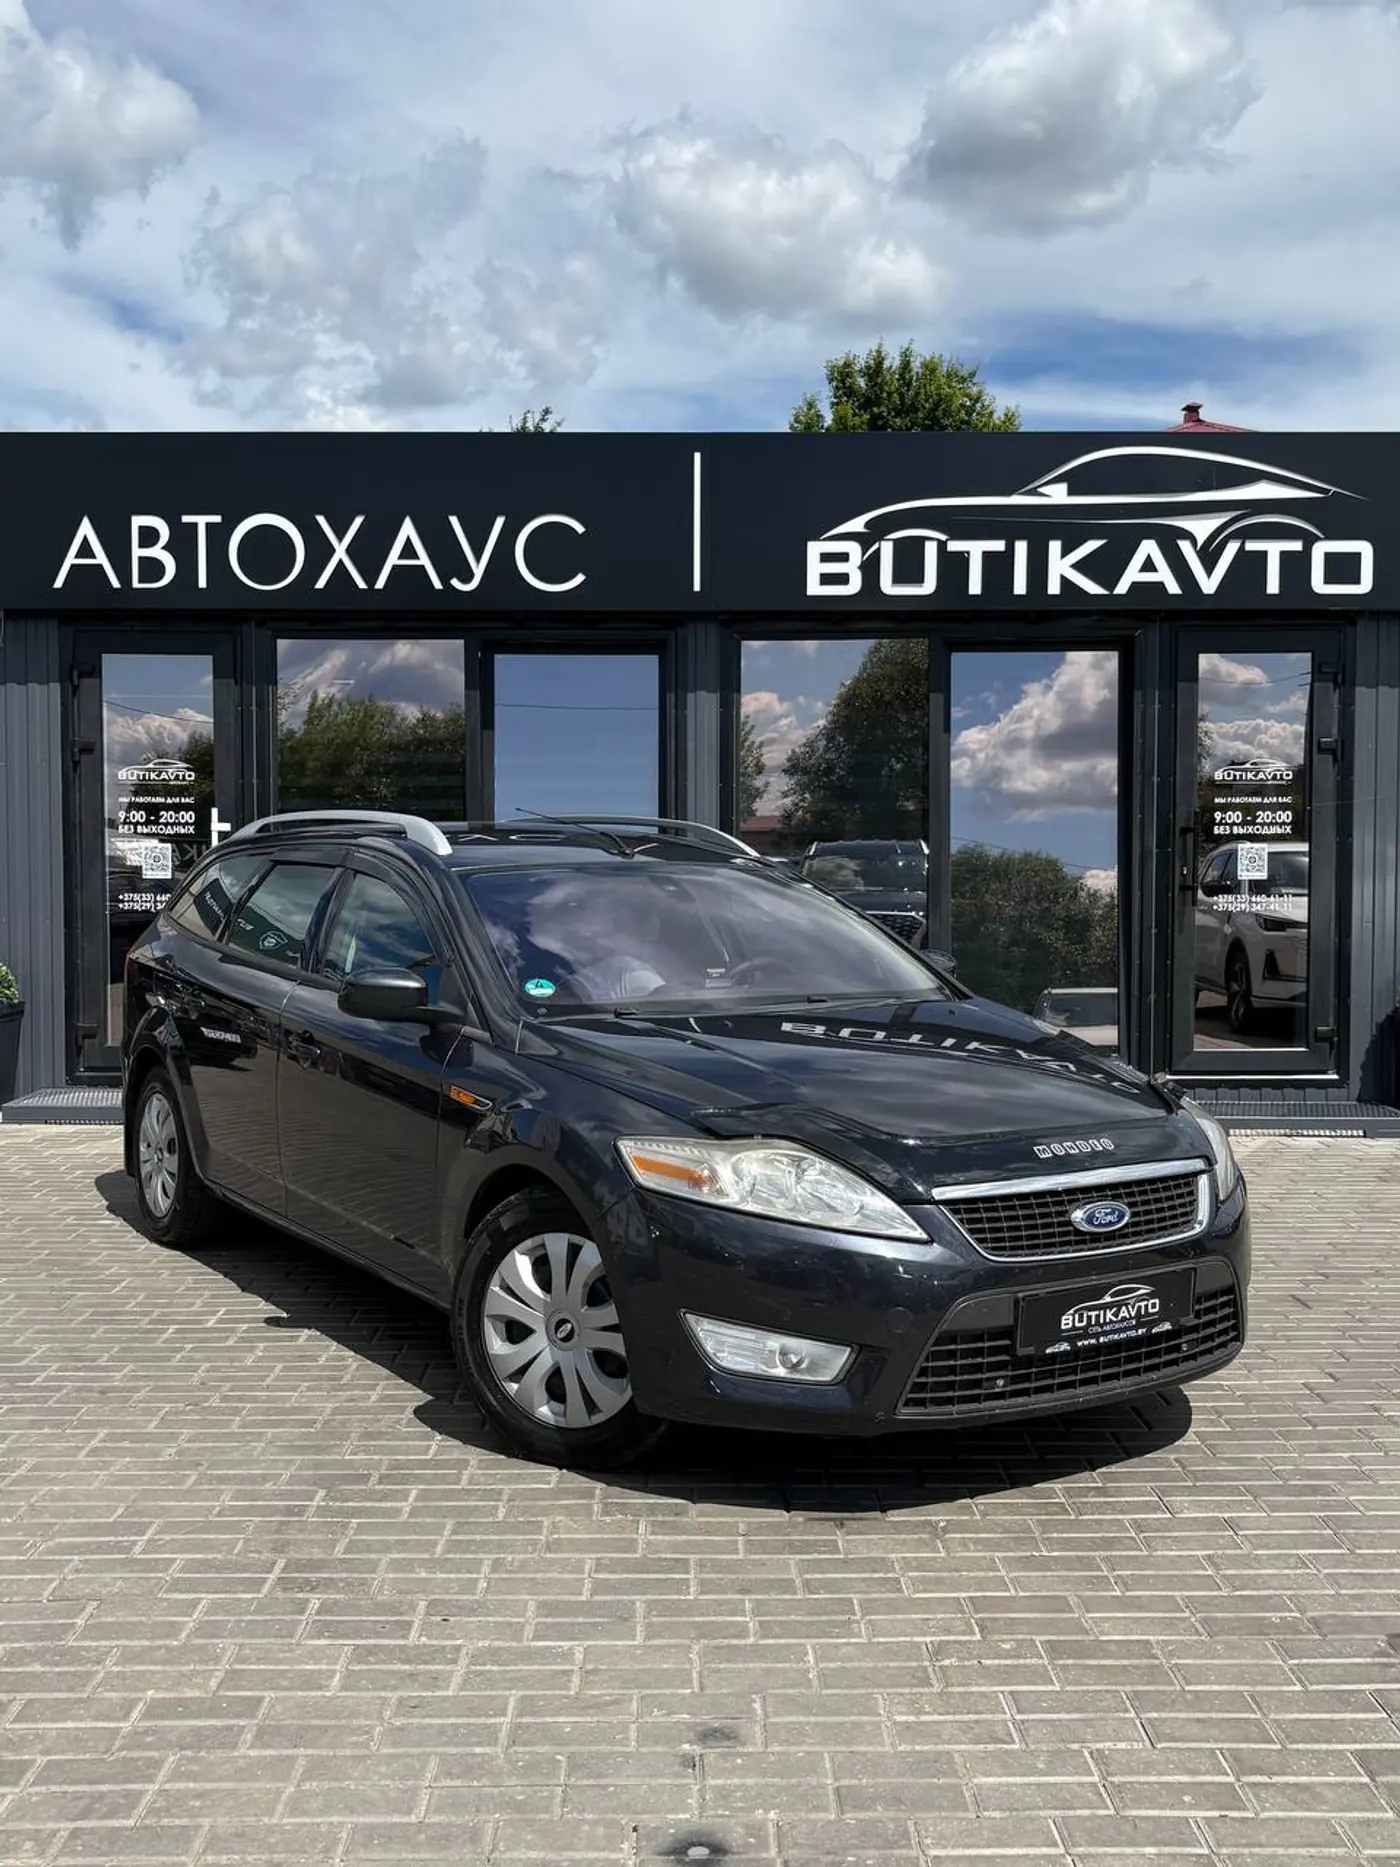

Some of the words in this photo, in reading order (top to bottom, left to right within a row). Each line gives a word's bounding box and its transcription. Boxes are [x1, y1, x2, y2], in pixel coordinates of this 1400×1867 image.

[53, 513, 587, 592] АВТОХАУС
[806, 539, 1373, 596] BUTIKAVTO
[1214, 770, 1293, 780] BUTIKAVTO
[118, 811, 146, 823] 9:00
[159, 811, 195, 823] 20:00
[1214, 811, 1242, 823] 9:00
[1256, 811, 1292, 823] 20:00
[137, 825, 195, 835] ВЫХОДНЫХ
[1214, 825, 1230, 834] БЕЗ
[1233, 825, 1292, 835] ВЫХОДНЫХ
[1033, 1138, 1115, 1158] MONDEO
[1093, 1208, 1120, 1225] Ford
[1060, 1298, 1160, 1330] BUTIKAVTO
